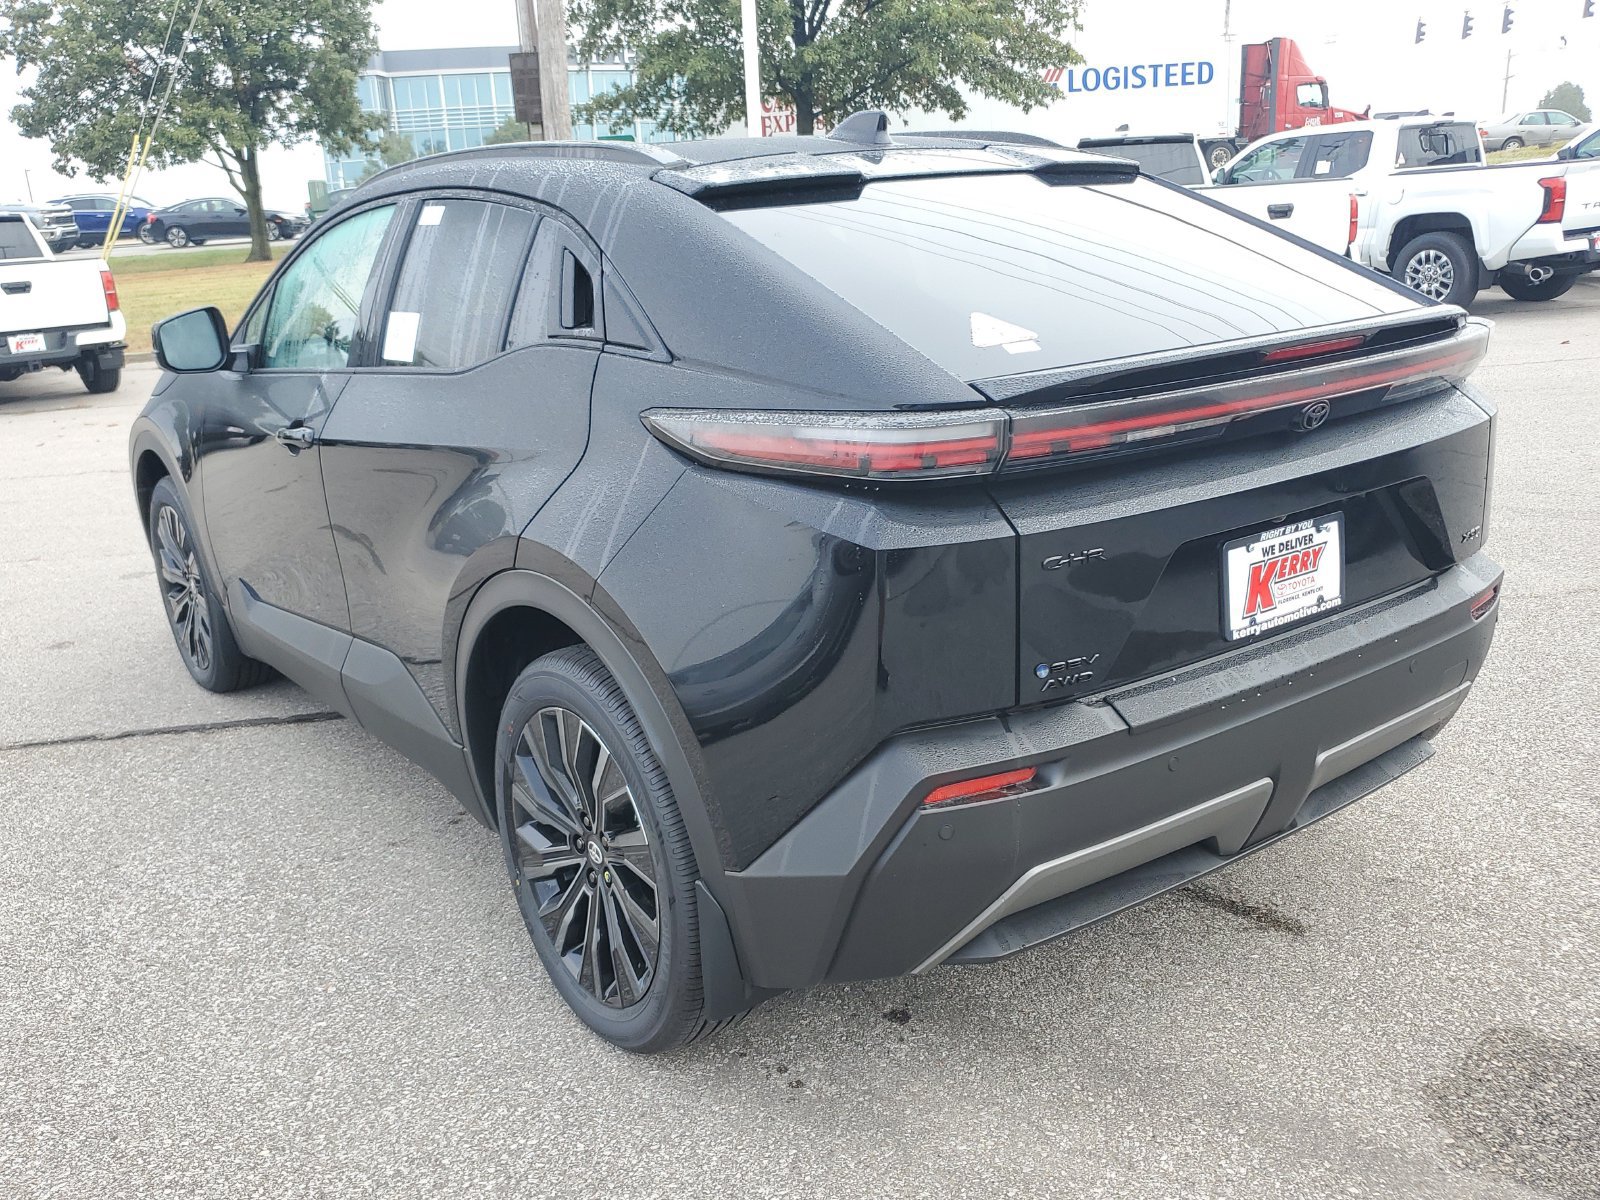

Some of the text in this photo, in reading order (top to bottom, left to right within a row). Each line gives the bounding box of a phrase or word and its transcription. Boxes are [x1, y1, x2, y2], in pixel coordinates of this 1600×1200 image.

[1068, 61, 1214, 93] LOGISTEED
[1260, 519, 1314, 541] RIGHT BY YOU
[1262, 533, 1314, 558] WE DELIVER
[1244, 545, 1324, 615] KERRY
[1288, 575, 1316, 590] TOYOTA
[1232, 597, 1342, 641] kerryautomotive.com
[1040, 671, 1094, 692] AWD
